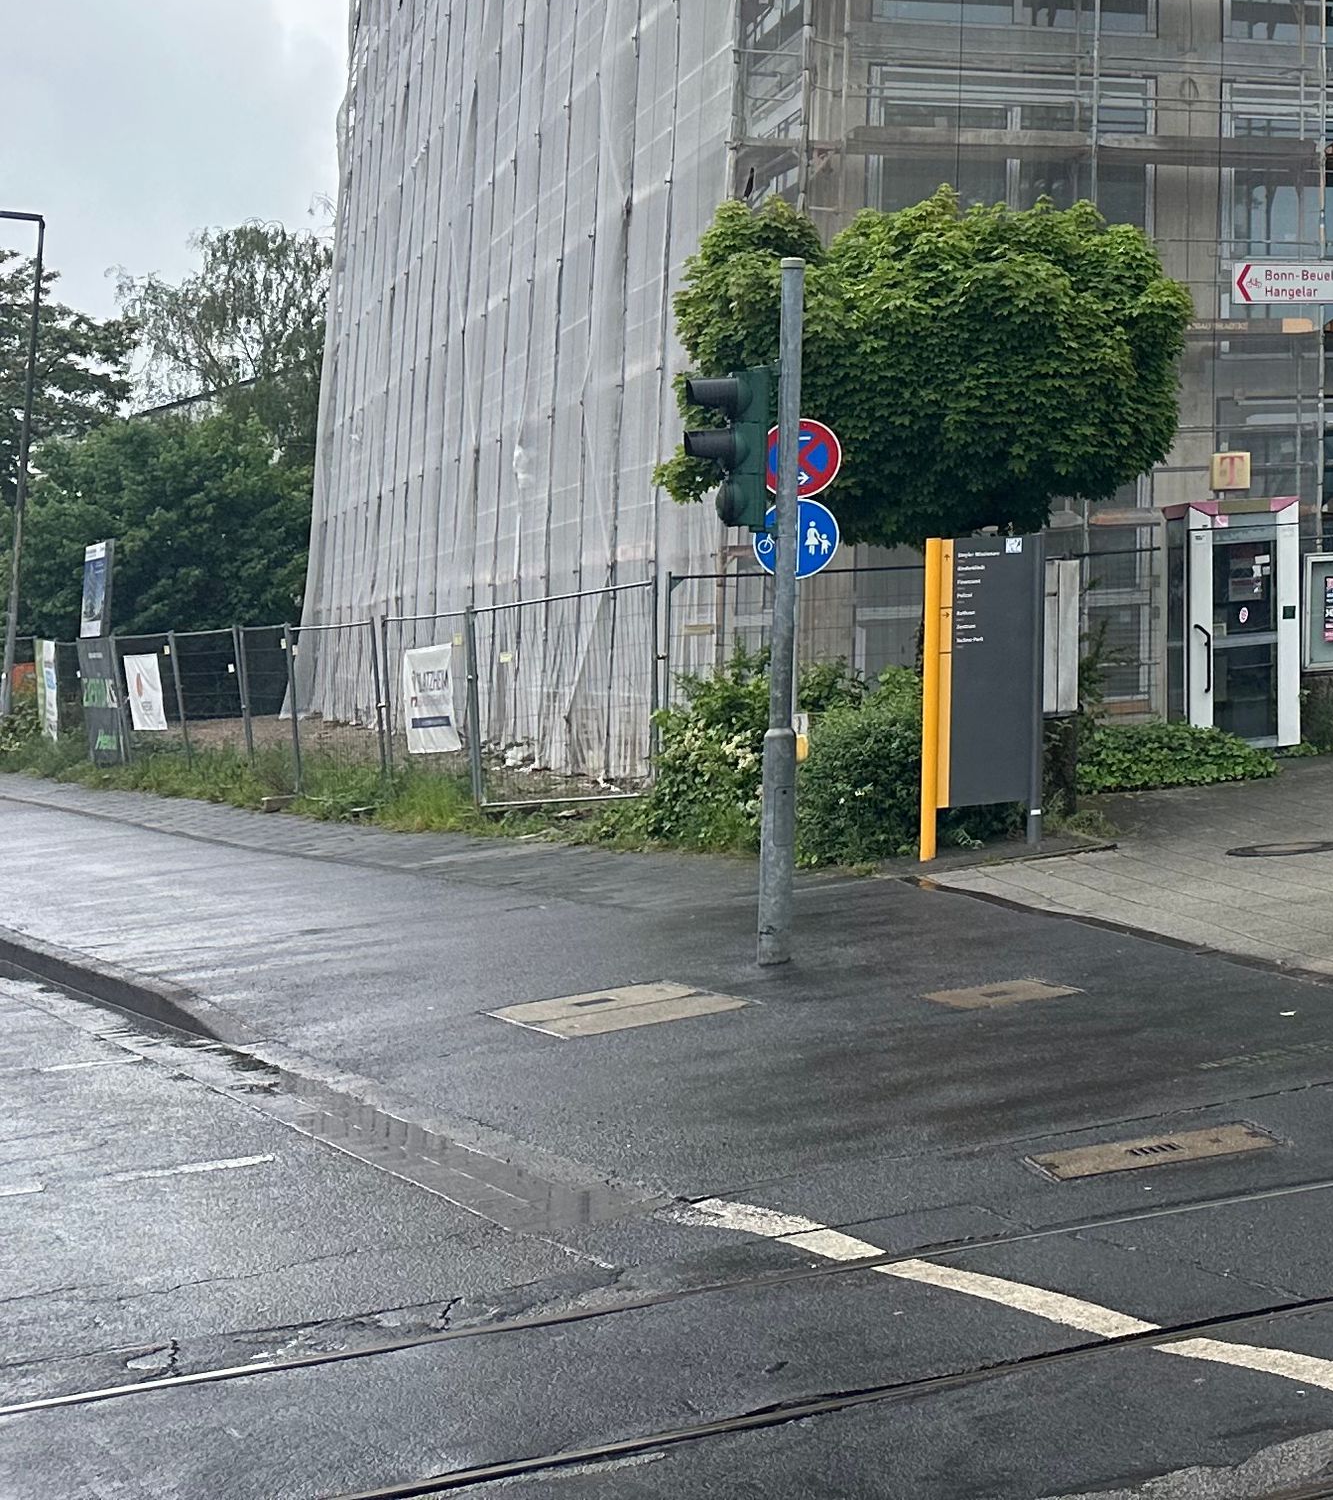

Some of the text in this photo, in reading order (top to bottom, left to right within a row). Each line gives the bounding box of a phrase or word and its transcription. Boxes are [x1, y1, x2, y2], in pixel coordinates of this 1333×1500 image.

[1265, 269, 1333, 281] Bonn-Beuel
[1265, 286, 1318, 300] Hangelar
[1219, 455, 1245, 487] T
